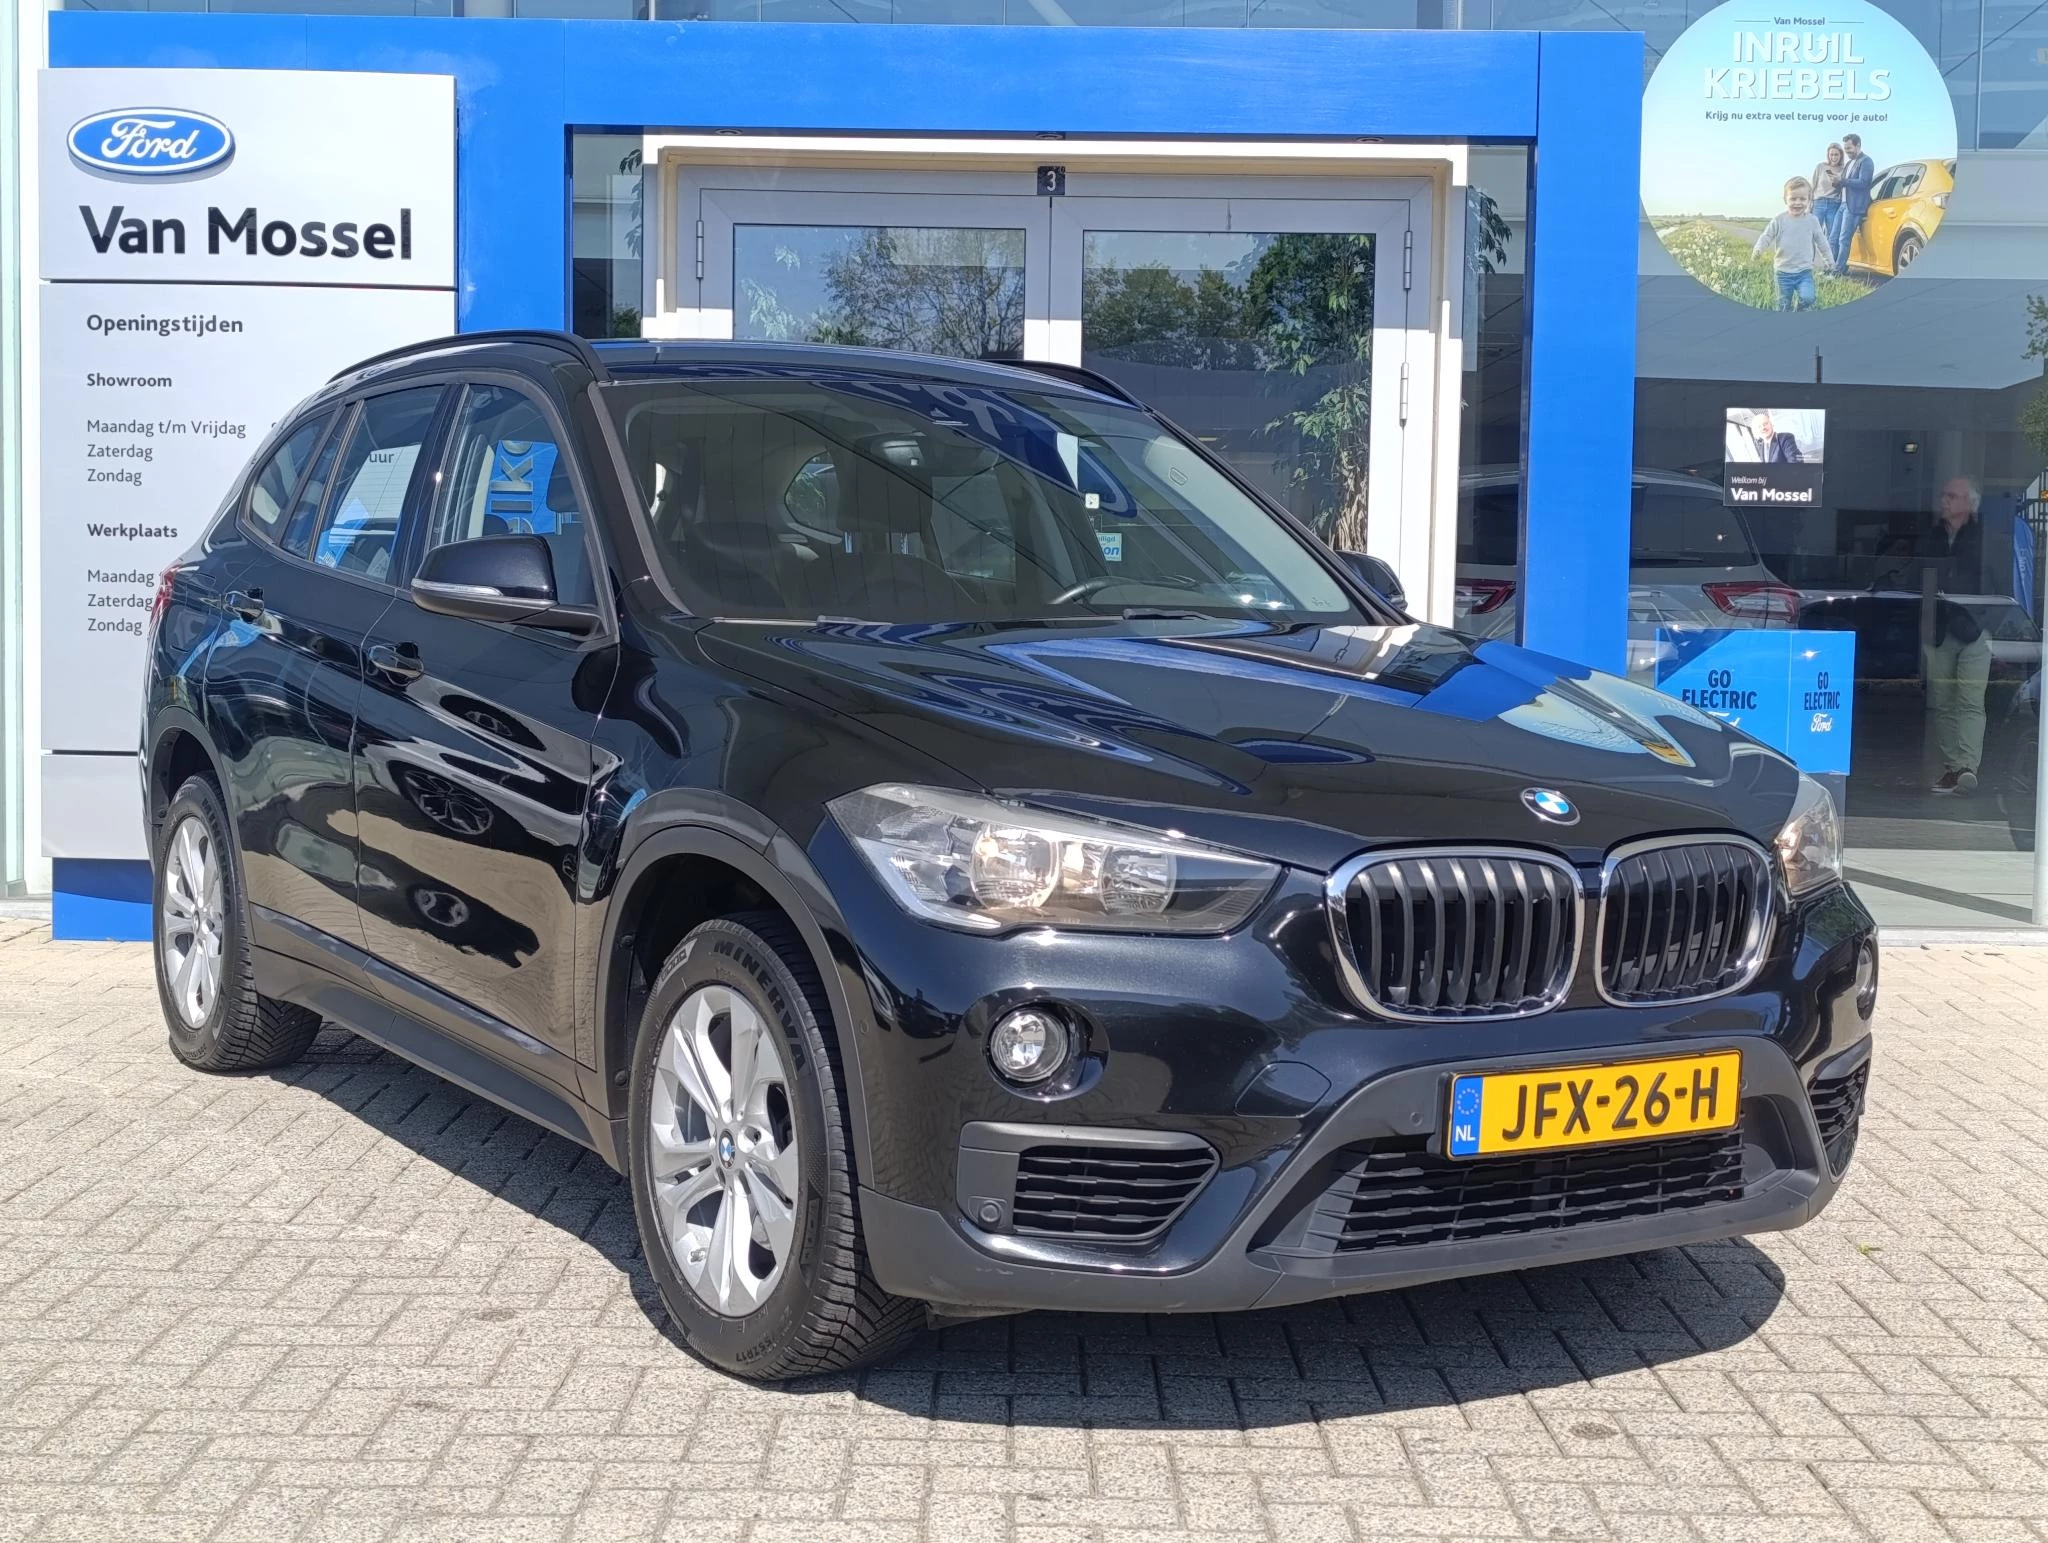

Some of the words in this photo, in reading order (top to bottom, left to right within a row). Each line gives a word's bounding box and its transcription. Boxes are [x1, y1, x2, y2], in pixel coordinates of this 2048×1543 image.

[1773, 16, 1791, 26] Van
[1793, 16, 1826, 26] Mossel
[1733, 31, 1865, 64] INRUIL
[1703, 67, 1892, 101] KRIEBELS
[1705, 111, 1729, 122] Krijg
[1745, 112, 1772, 121] extra
[1774, 112, 1795, 121] veel
[1797, 112, 1824, 123] terug
[1826, 114, 1848, 122] voor
[1849, 112, 1860, 123] je
[1862, 112, 1888, 122] auto!
[101, 117, 200, 161] Ford
[1046, 170, 1057, 192] 3
[79, 205, 186, 255] Van
[207, 206, 412, 261] Mossel
[86, 314, 244, 338] Openingstijden
[86, 372, 173, 388] Showroom
[87, 419, 154, 438] Maandag
[158, 420, 186, 434] t/m
[191, 420, 247, 439] Vrijdag
[87, 443, 154, 462] Zaterdag
[369, 452, 395, 464] uur
[87, 468, 143, 487] Zondag
[1730, 487, 1758, 501] Van
[1762, 487, 1813, 502] Mossel
[87, 523, 178, 541] Werkplaats
[87, 569, 155, 588] Maandag
[87, 593, 153, 612] Zaterdag
[87, 618, 143, 636] Zondag
[1708, 669, 1732, 689] GO
[1817, 671, 1829, 690] GO
[1682, 689, 1758, 710] ELECTRIC
[1803, 690, 1841, 711] ELECTRIC
[1810, 712, 1833, 732] Ford
[713, 940, 806, 1073] MINERVA
[1502, 1066, 1720, 1142] JFX-26-H
[1455, 1124, 1476, 1142] NL
